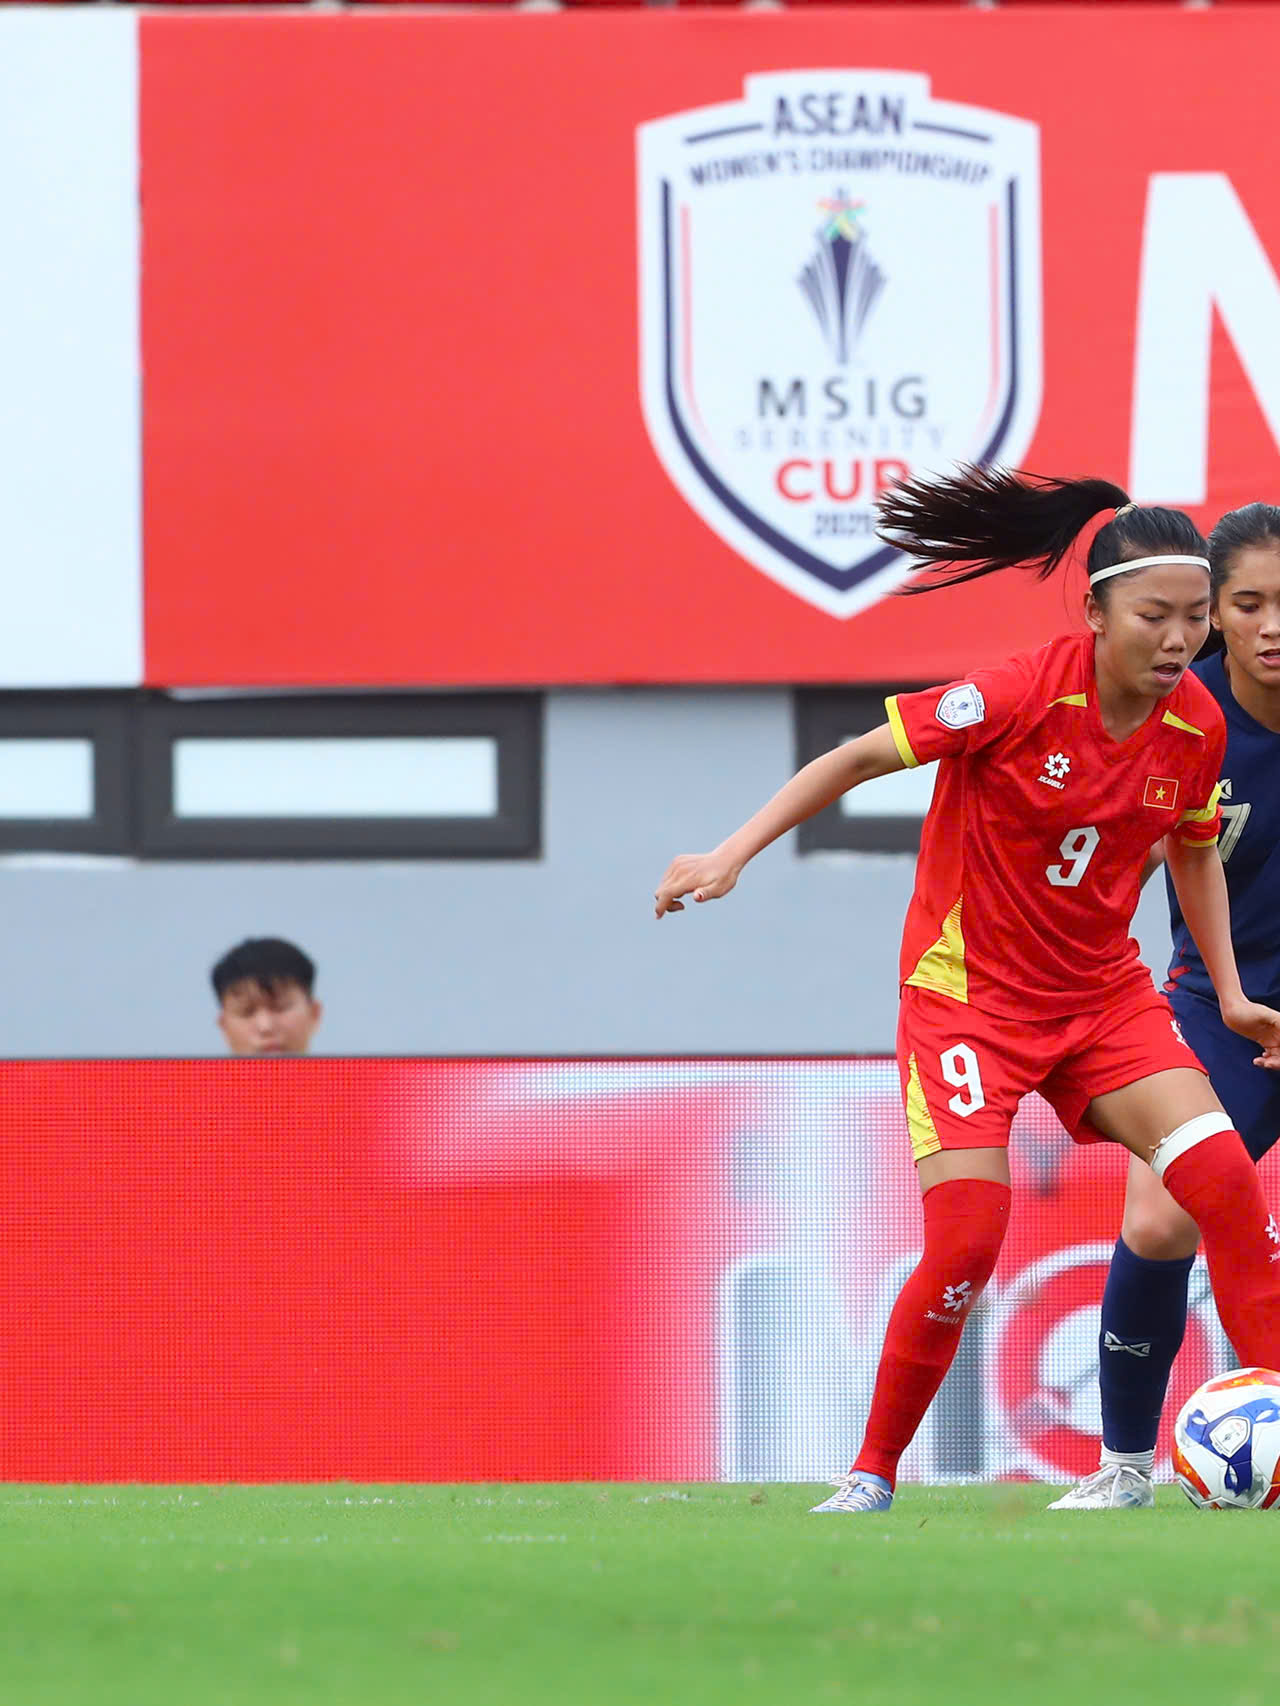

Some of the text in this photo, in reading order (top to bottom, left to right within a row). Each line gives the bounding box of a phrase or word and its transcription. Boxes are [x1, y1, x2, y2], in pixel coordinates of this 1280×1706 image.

[774, 93, 906, 136] ASEAN
[689, 148, 991, 187] WOMEN'S CHAMPIONSHIP
[757, 375, 927, 422] MSIG
[733, 427, 946, 449] SERENITY
[775, 458, 909, 502] CUP
[1045, 826, 1101, 887] 9
[939, 1042, 986, 1118] 9
